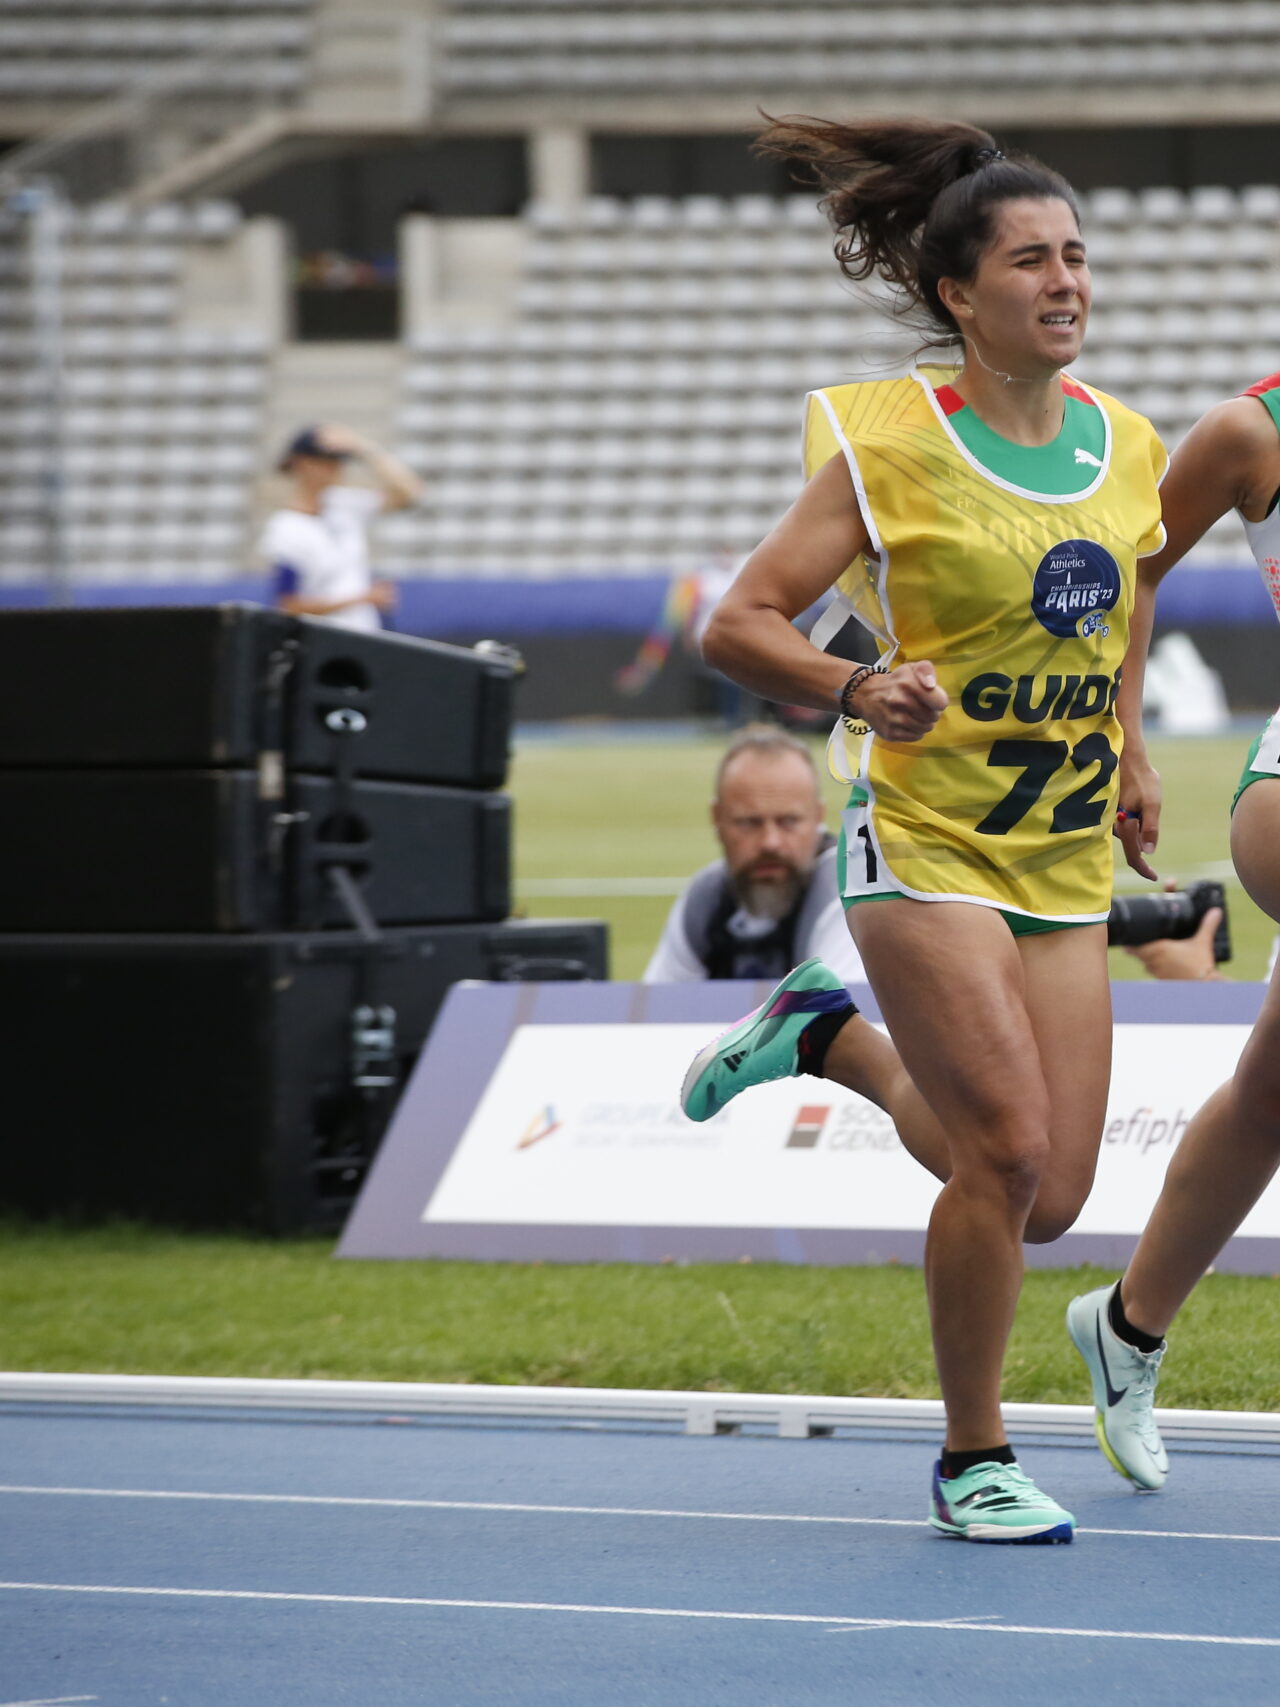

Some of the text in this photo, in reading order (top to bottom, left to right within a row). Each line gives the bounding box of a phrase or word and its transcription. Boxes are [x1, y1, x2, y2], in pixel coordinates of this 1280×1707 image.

[1050, 558, 1086, 570] Athletics
[974, 732, 1119, 835] 72
[857, 824, 878, 883] 1
